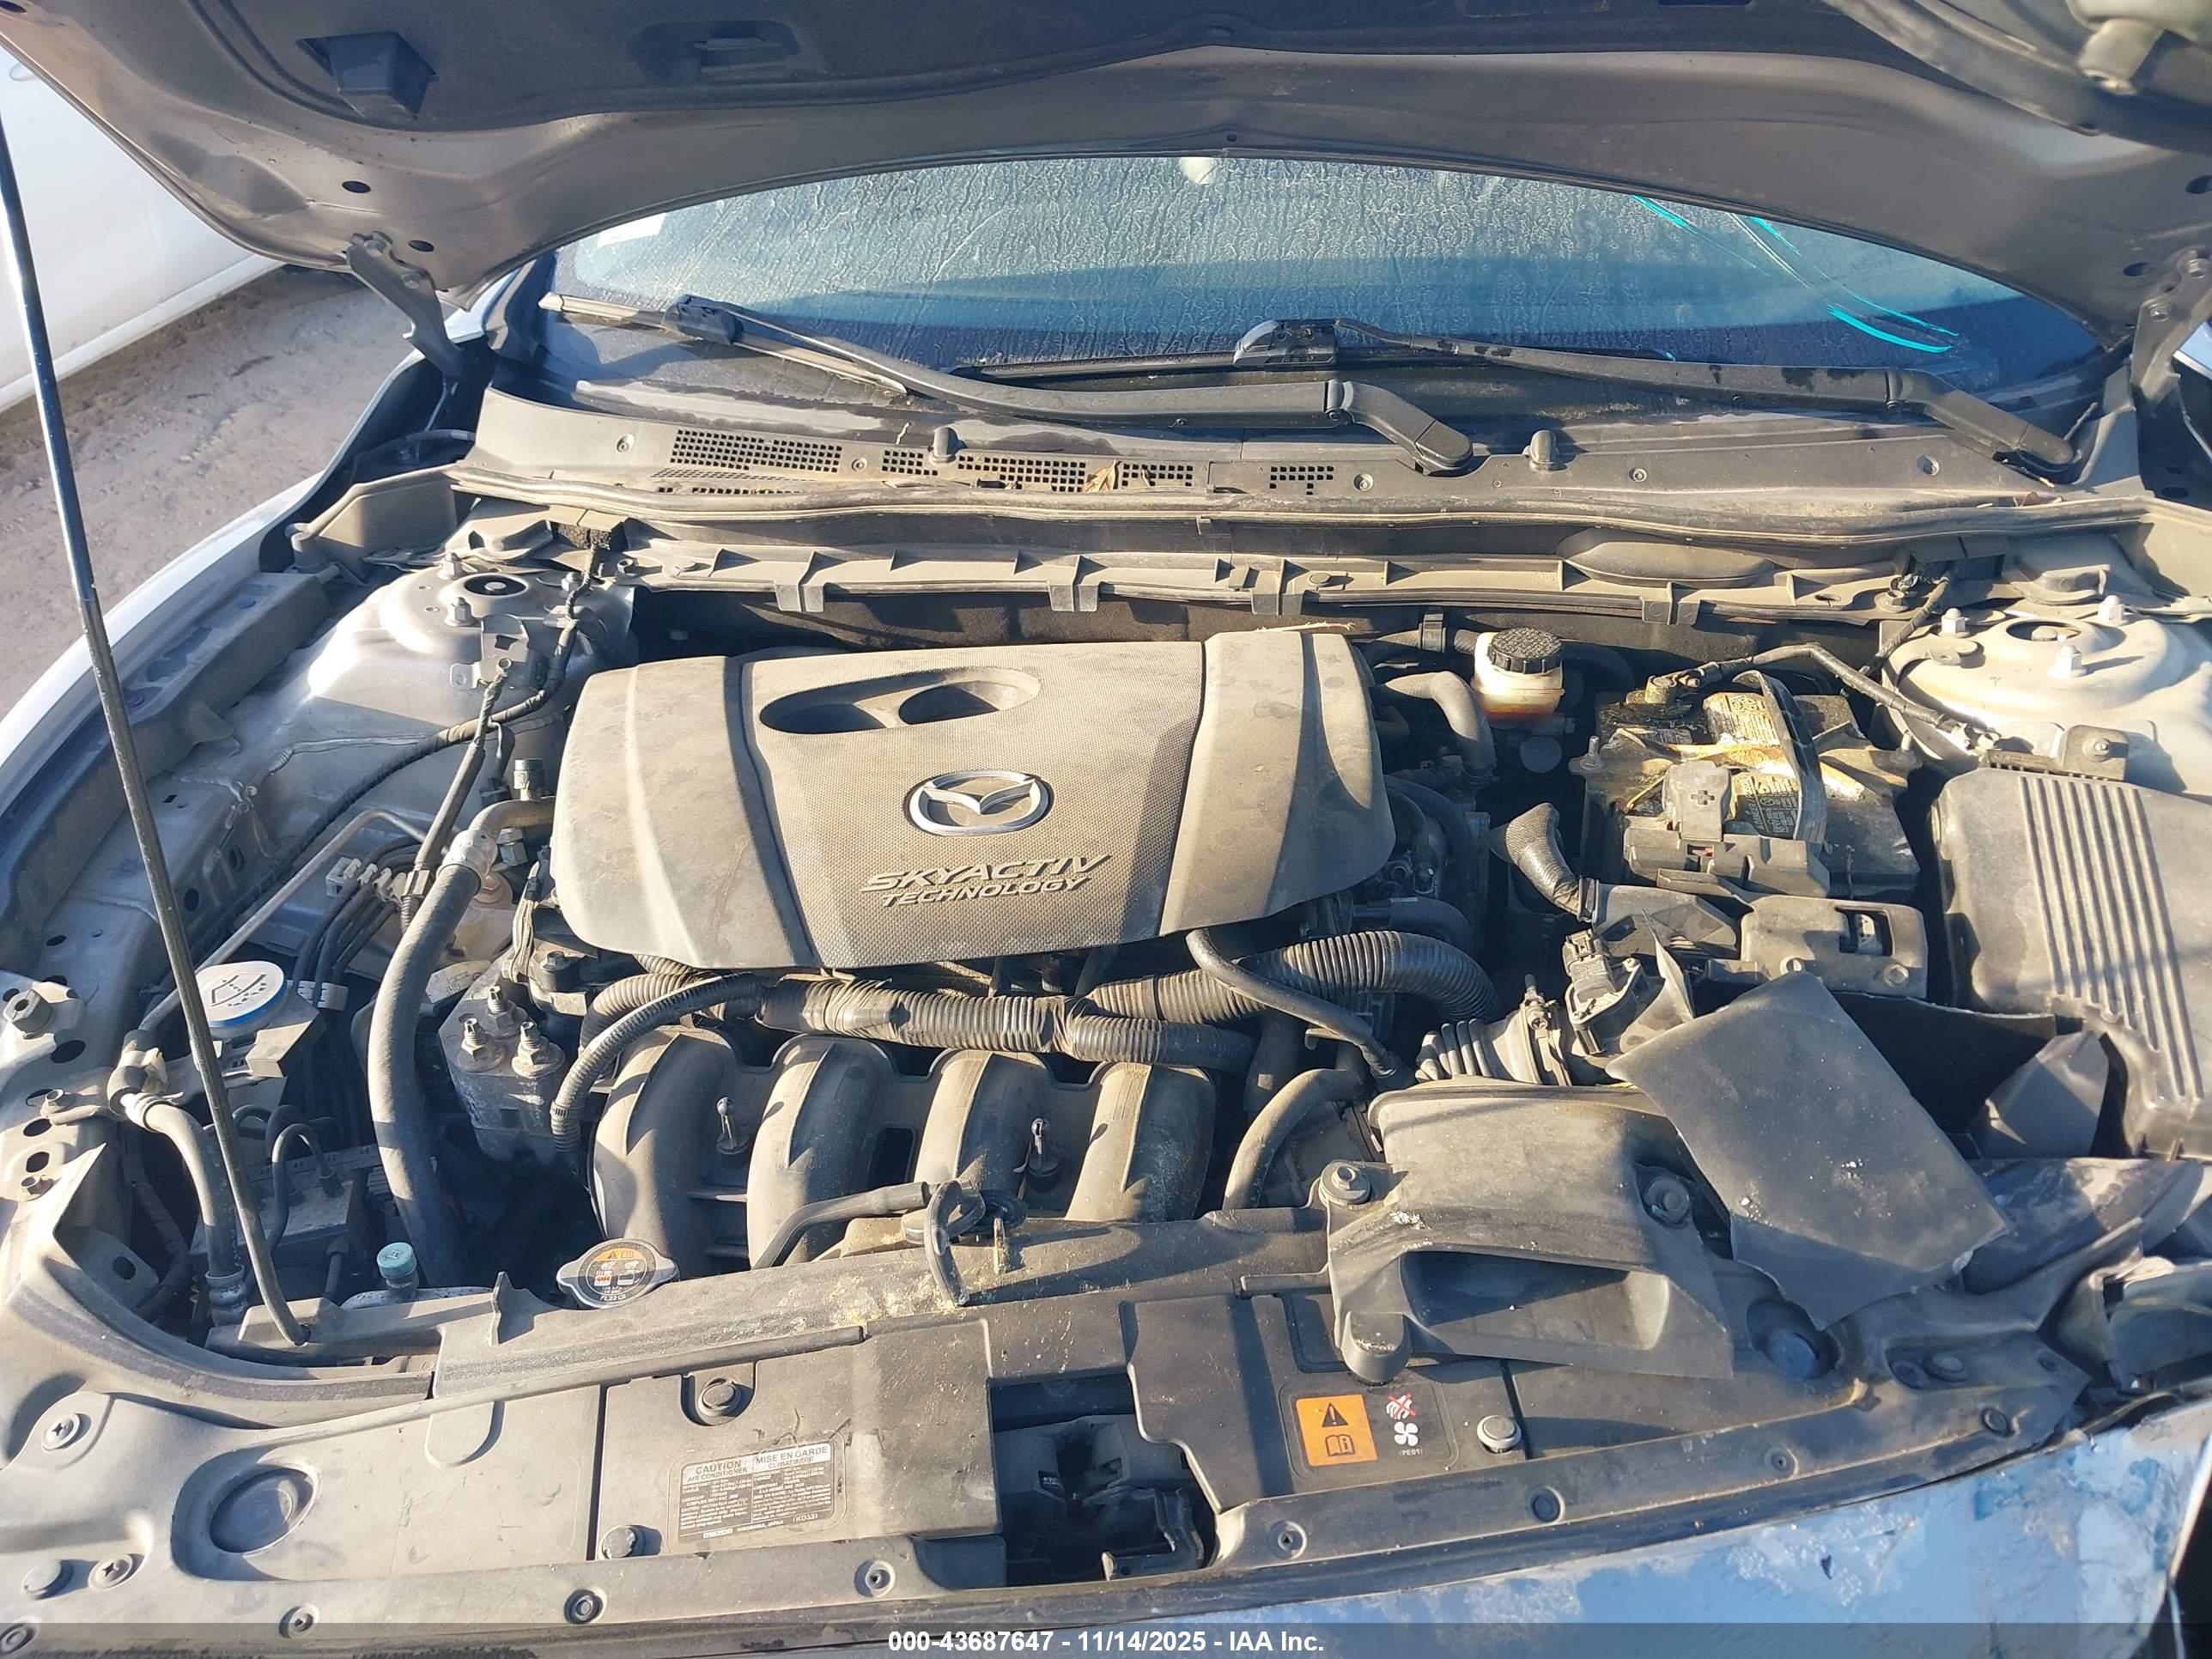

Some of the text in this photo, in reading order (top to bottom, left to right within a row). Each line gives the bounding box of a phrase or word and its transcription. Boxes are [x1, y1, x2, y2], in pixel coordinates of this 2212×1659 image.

[861, 854, 1113, 893] SKYACTIV
[883, 877, 1092, 908] TECHNOLOGY
[756, 1454, 779, 1464] MISE
[795, 1446, 828, 1458] GARDE
[696, 1459, 741, 1475] CAUTION
[701, 1467, 748, 1480] CONDITIONER
